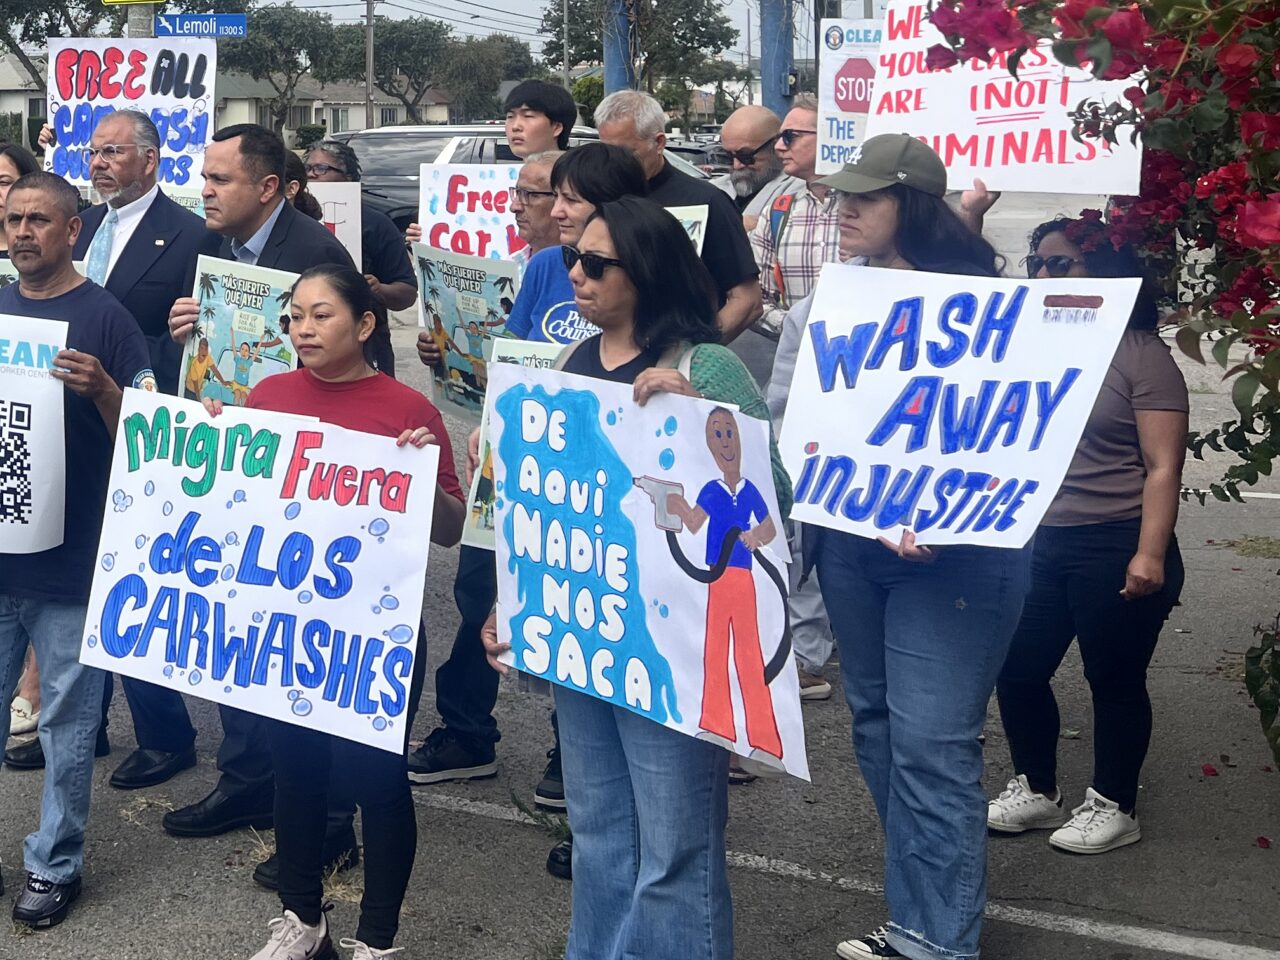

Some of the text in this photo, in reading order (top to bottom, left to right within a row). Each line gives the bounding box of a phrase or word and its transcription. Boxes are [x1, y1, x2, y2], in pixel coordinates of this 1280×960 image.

[175, 17, 244, 35] Lemoli 11300 S
[846, 28, 882, 44] CLEA
[55, 47, 208, 101] FREE ALL
[876, 88, 928, 116] ARE
[825, 117, 856, 140] THE
[821, 144, 859, 164] DEPO
[446, 174, 509, 215] Free
[221, 273, 270, 296] MÁS FUERTES
[437, 260, 487, 282] MÁS FUERTES
[443, 274, 482, 294] QUE AYER
[224, 289, 263, 310] QUE AYER
[808, 285, 1029, 393] WASH
[27, 369, 58, 381] CENTE
[520, 398, 568, 454] DE
[866, 367, 1083, 455] AWAY
[123, 405, 412, 514] Migra Fuera
[148, 510, 363, 600] de LOS
[542, 578, 628, 644] NOS
[100, 573, 415, 719] CARWASHES
[520, 615, 653, 713] SACA
